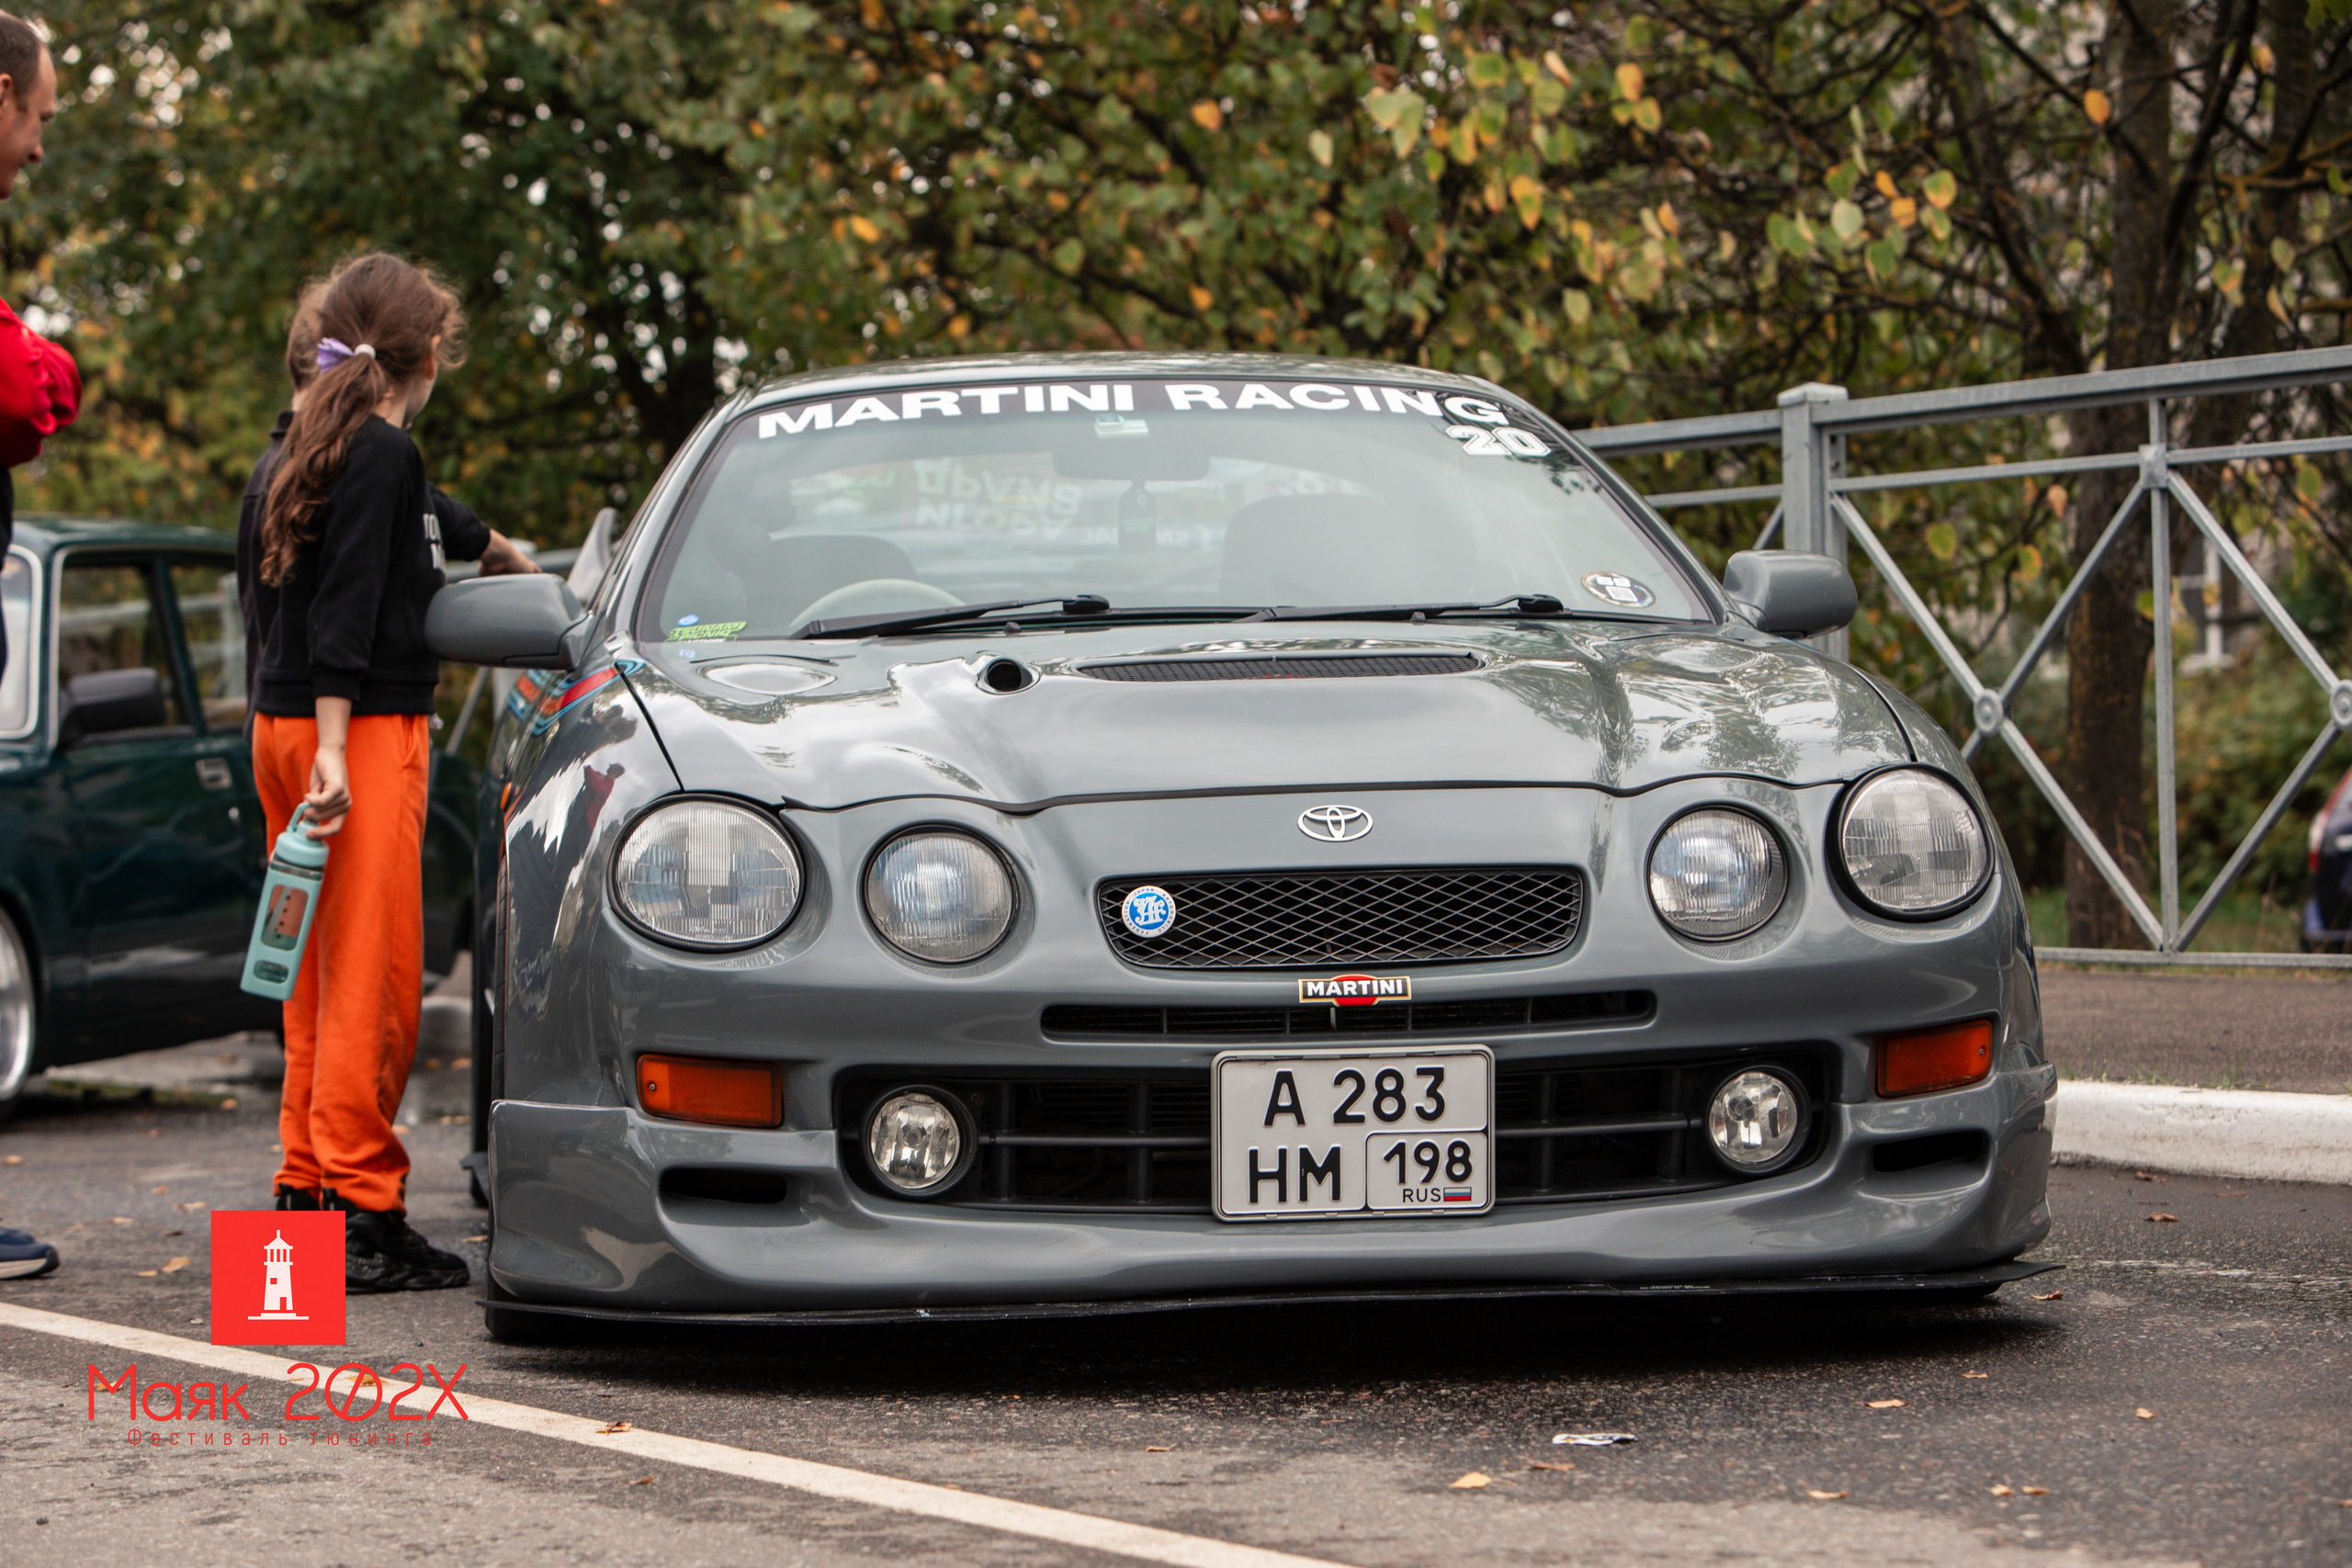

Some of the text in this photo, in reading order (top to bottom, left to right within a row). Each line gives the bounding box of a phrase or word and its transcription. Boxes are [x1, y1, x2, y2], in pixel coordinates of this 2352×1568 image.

[759, 384, 1509, 439] MARTINI RACING
[1445, 424, 1552, 457] 20
[1306, 979, 1403, 997] MARTINI
[1263, 1066, 1446, 1126] A 283
[1248, 1145, 1341, 1203] HM
[1383, 1141, 1473, 1185] 198
[1402, 1188, 1442, 1202] RUS
